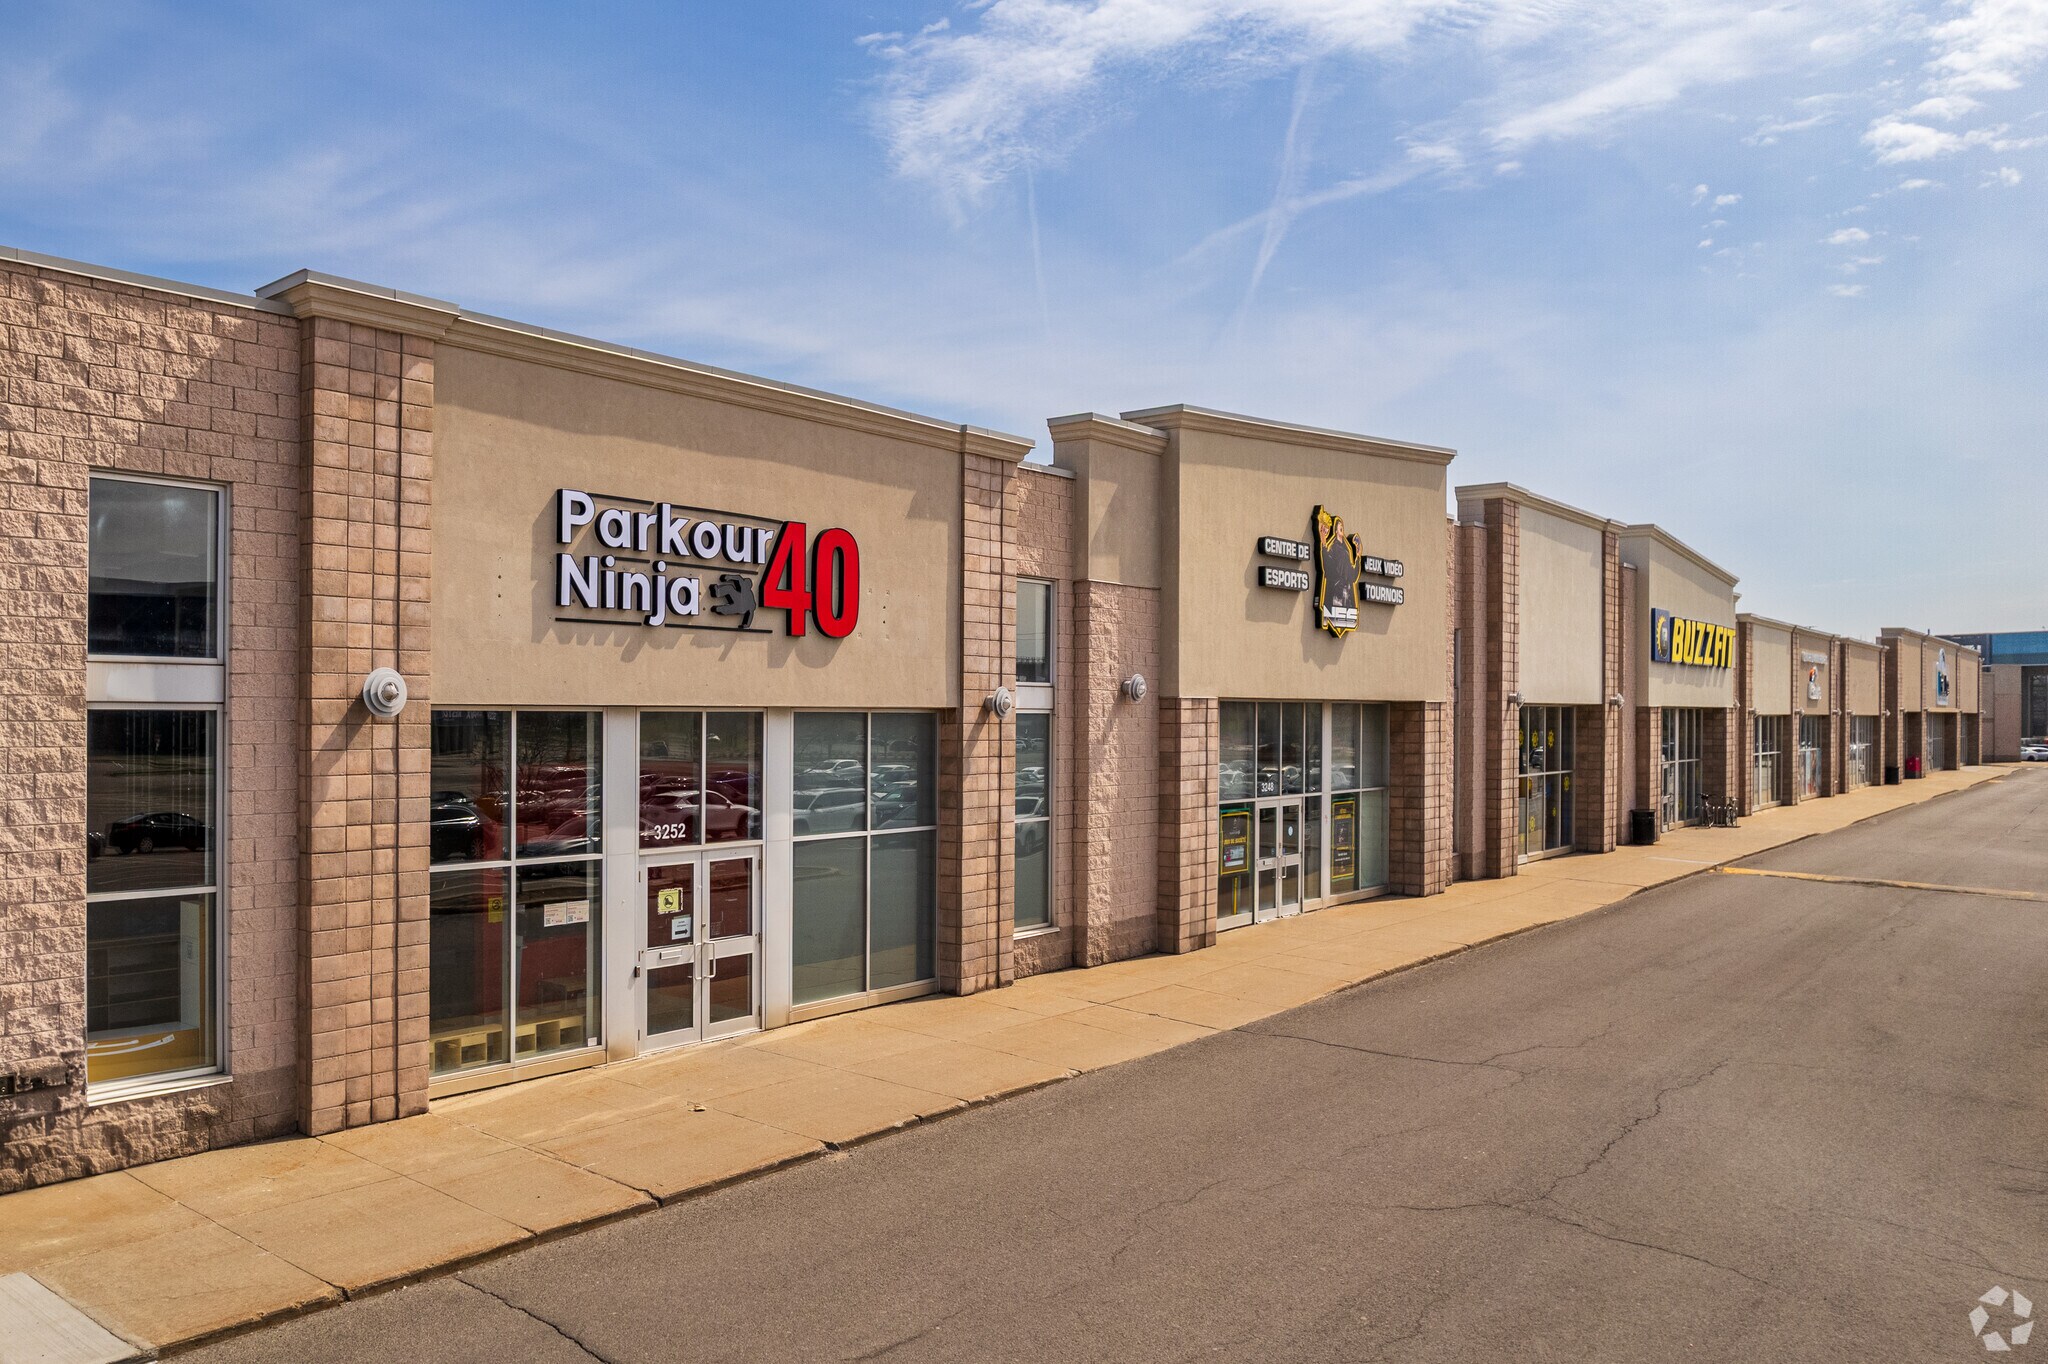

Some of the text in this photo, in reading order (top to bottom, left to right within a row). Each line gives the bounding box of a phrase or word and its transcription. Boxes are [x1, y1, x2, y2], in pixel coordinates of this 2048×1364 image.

[558, 488, 774, 564] Parkour
[1265, 538, 1310, 559] CENTRE DE
[1365, 557, 1403, 577] JEUX VIDÉO
[557, 553, 700, 626] Ninja
[759, 521, 860, 638] 40
[1265, 568, 1309, 590] ESPORTS
[1365, 584, 1404, 604] TOURNOIS
[1671, 617, 1736, 669] BUZZFIT
[654, 823, 686, 840] 3252
